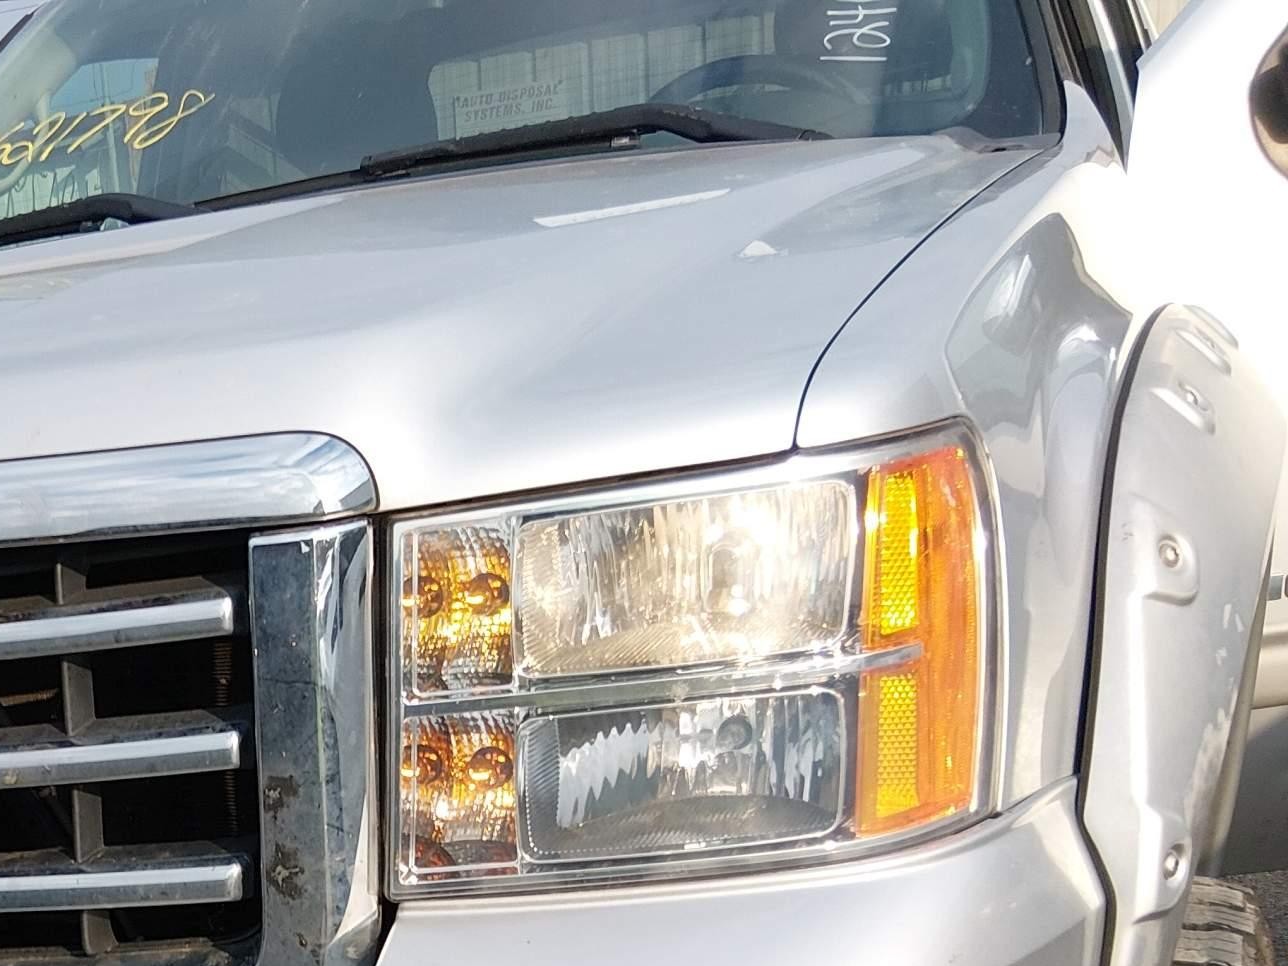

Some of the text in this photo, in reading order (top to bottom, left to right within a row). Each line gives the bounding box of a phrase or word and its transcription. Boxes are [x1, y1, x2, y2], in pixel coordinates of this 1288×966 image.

[819, 0, 898, 62] 124
[460, 83, 560, 109] AUTO DISPOSAL
